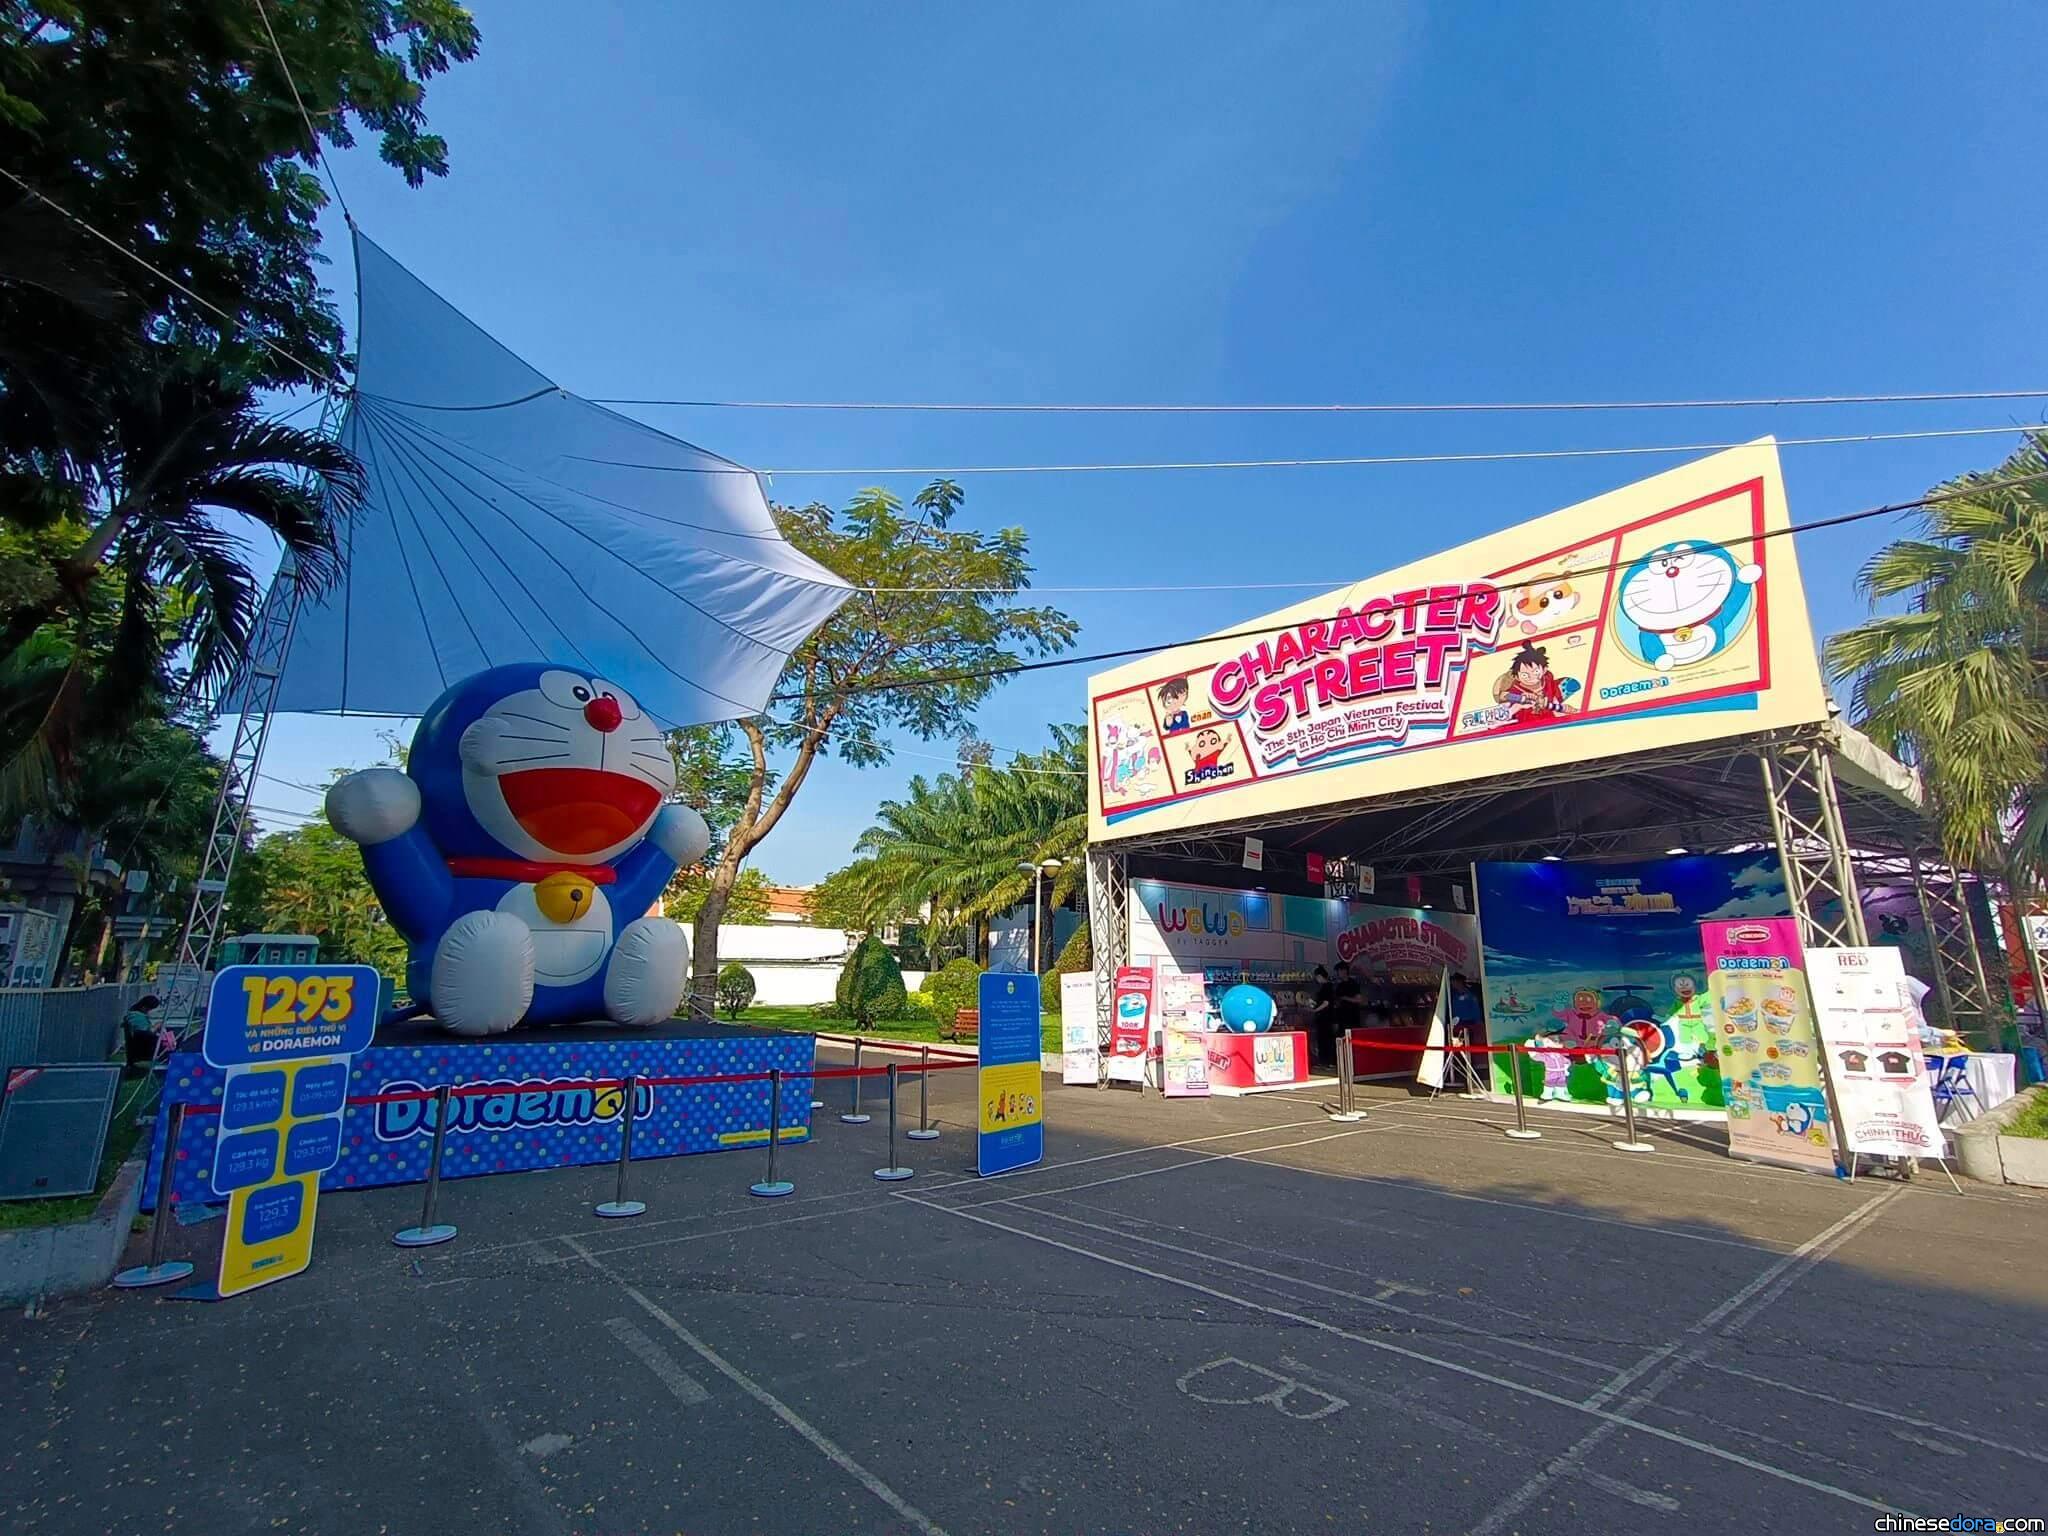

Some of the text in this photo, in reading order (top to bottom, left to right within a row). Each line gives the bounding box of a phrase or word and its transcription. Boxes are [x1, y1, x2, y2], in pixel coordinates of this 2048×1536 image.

[1211, 583, 1500, 706] CHARACTER
[1254, 632, 1459, 730] STREET
[1600, 676, 1669, 700] Doraemon
[1266, 699, 1445, 751] The 8th Japan Vietnam Festival
[1300, 737, 1310, 749] in
[1350, 720, 1376, 734] Minh
[1379, 716, 1404, 731] City
[1186, 765, 1234, 784] Shinchan
[1718, 956, 1789, 970] Doraemon
[1838, 955, 1869, 967] RED
[242, 975, 355, 1026] 1293
[263, 1034, 341, 1051] DORAEMON
[375, 1078, 654, 1142] Doraemon
[260, 1204, 289, 1223] 129.3
